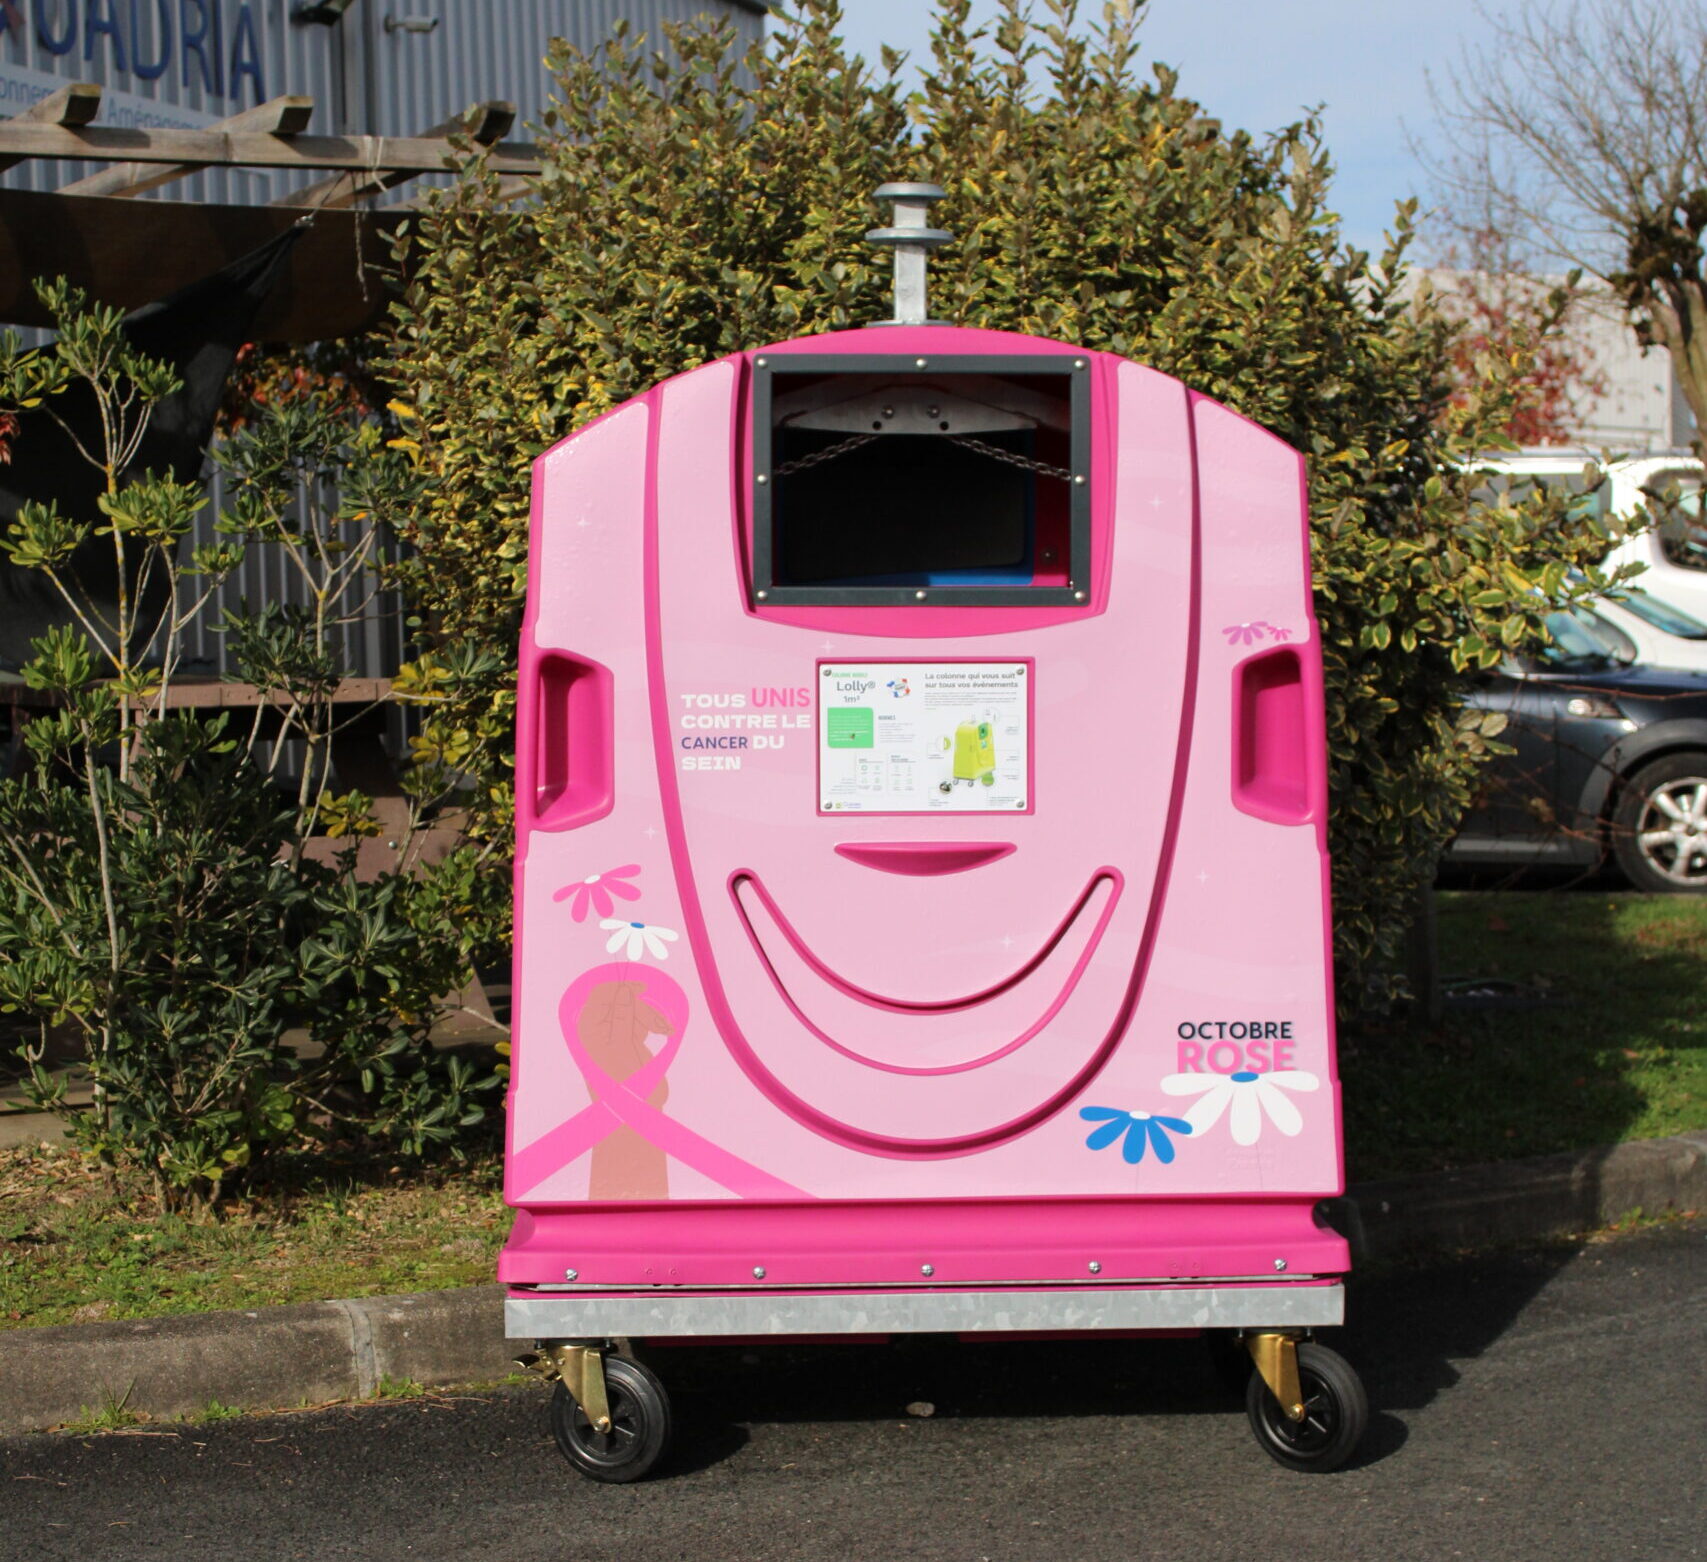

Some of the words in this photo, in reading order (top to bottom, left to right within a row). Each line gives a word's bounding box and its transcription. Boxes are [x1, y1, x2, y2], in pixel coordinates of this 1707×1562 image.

[924, 672, 935, 680] La
[936, 672, 967, 680] colonne
[968, 672, 980, 682] qui
[1001, 672, 1016, 680] suit
[681, 694, 746, 708] TOUS
[751, 687, 811, 708] UNIS
[681, 714, 777, 729] CONTRE
[782, 714, 811, 728] LE
[681, 736, 748, 750] CANCER
[752, 735, 785, 749] DU
[681, 756, 742, 770] SEIN
[1178, 1021, 1292, 1040] OCTOBRE
[1177, 1040, 1297, 1074] ROSE
